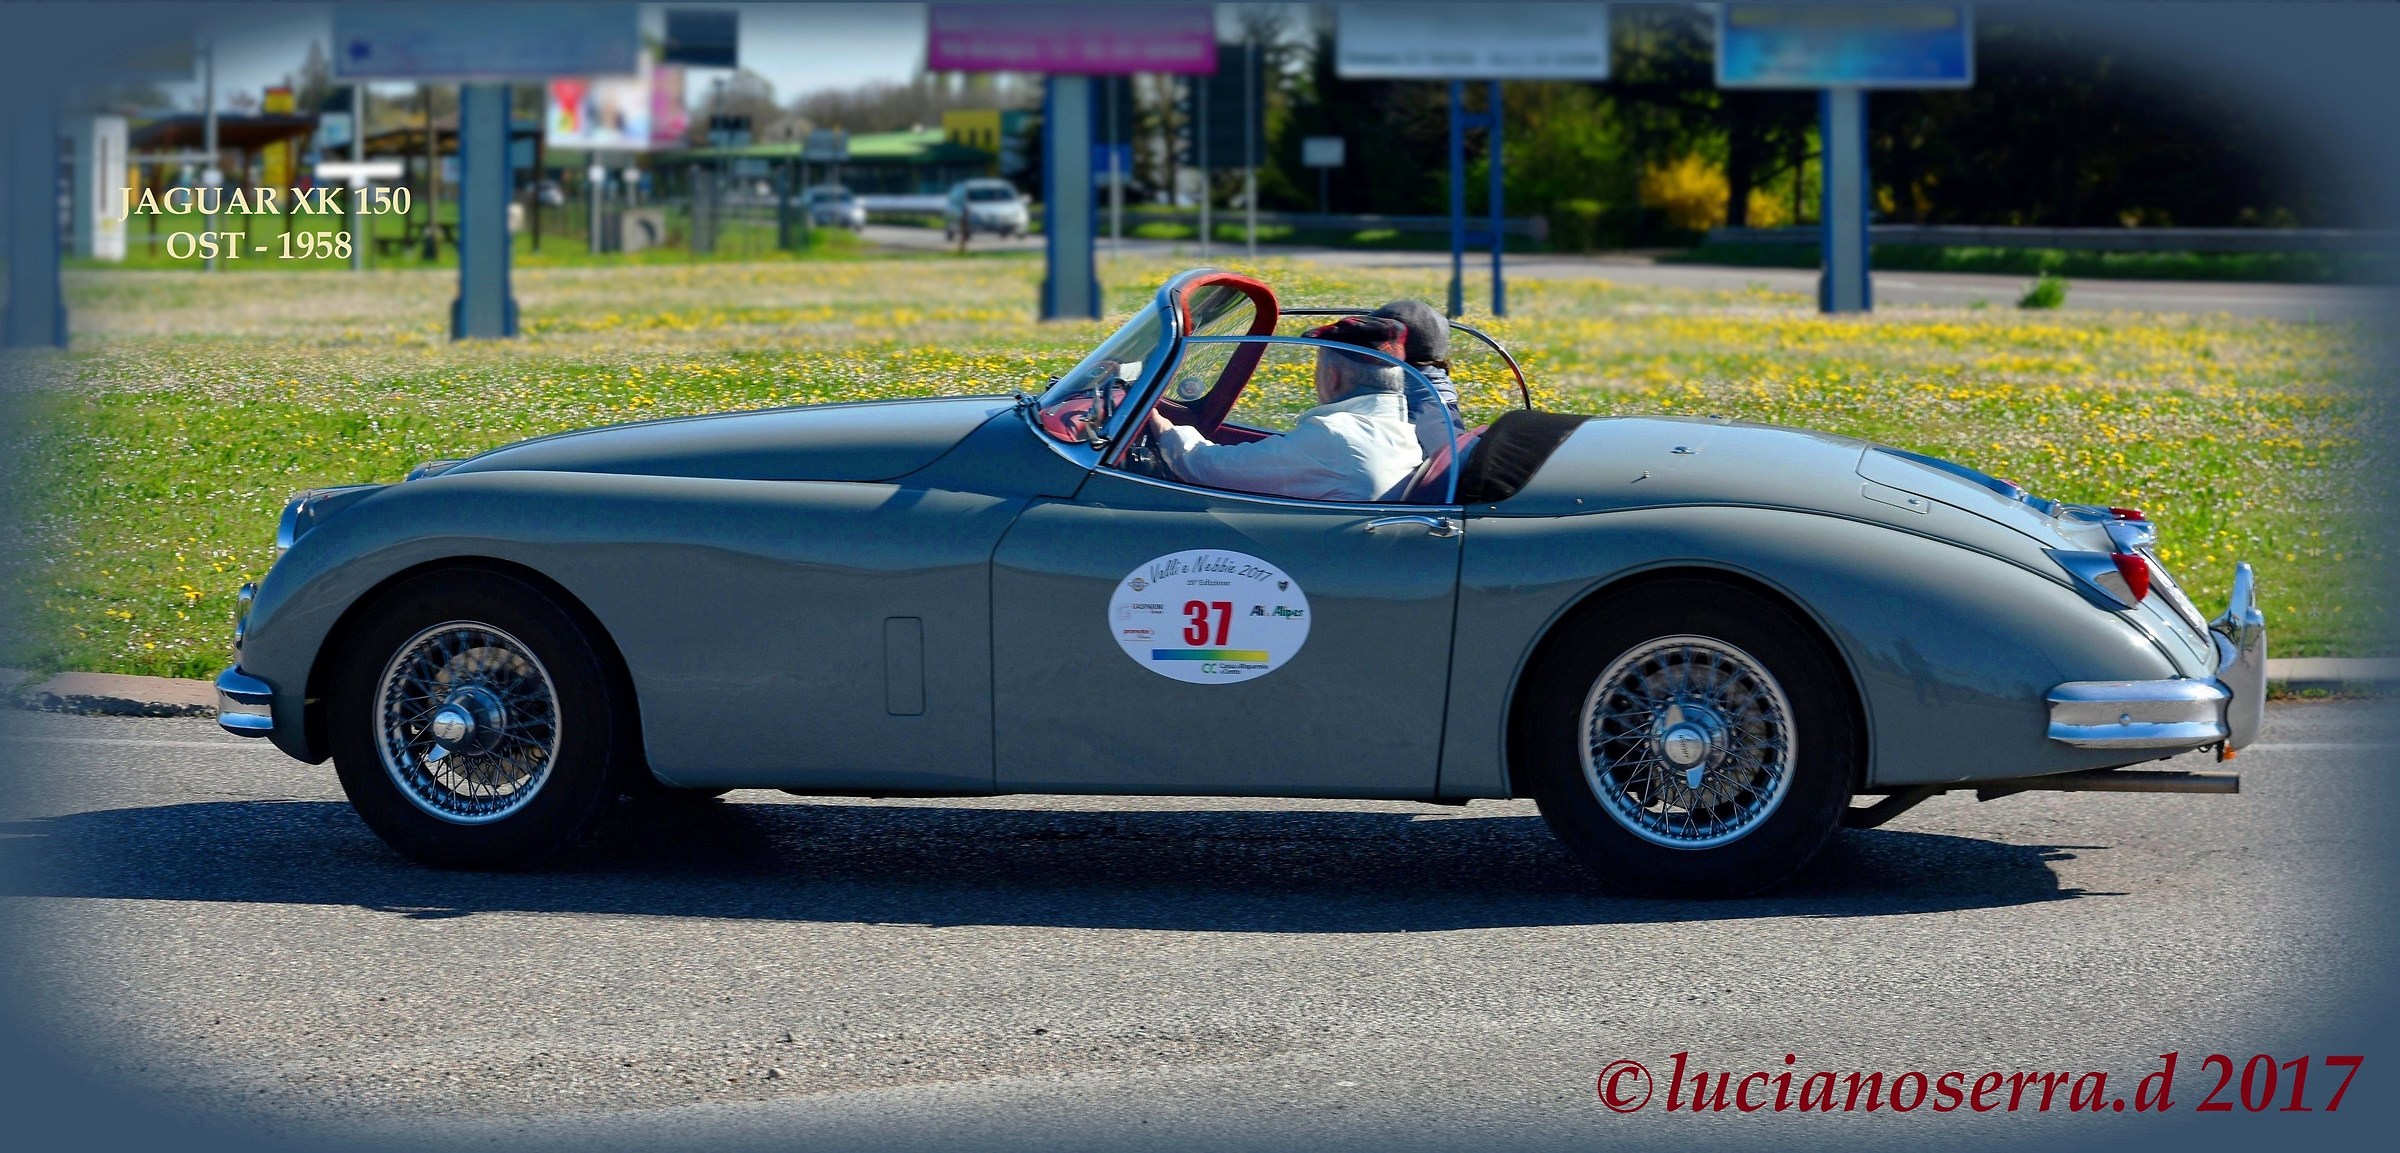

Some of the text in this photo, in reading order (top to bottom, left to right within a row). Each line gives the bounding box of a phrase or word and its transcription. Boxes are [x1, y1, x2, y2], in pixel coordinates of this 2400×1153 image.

[1150, 558, 1182, 583] Valli
[1191, 555, 1237, 574] Nebbie
[1238, 564, 1273, 582] 2017
[1183, 600, 1233, 646] 37
